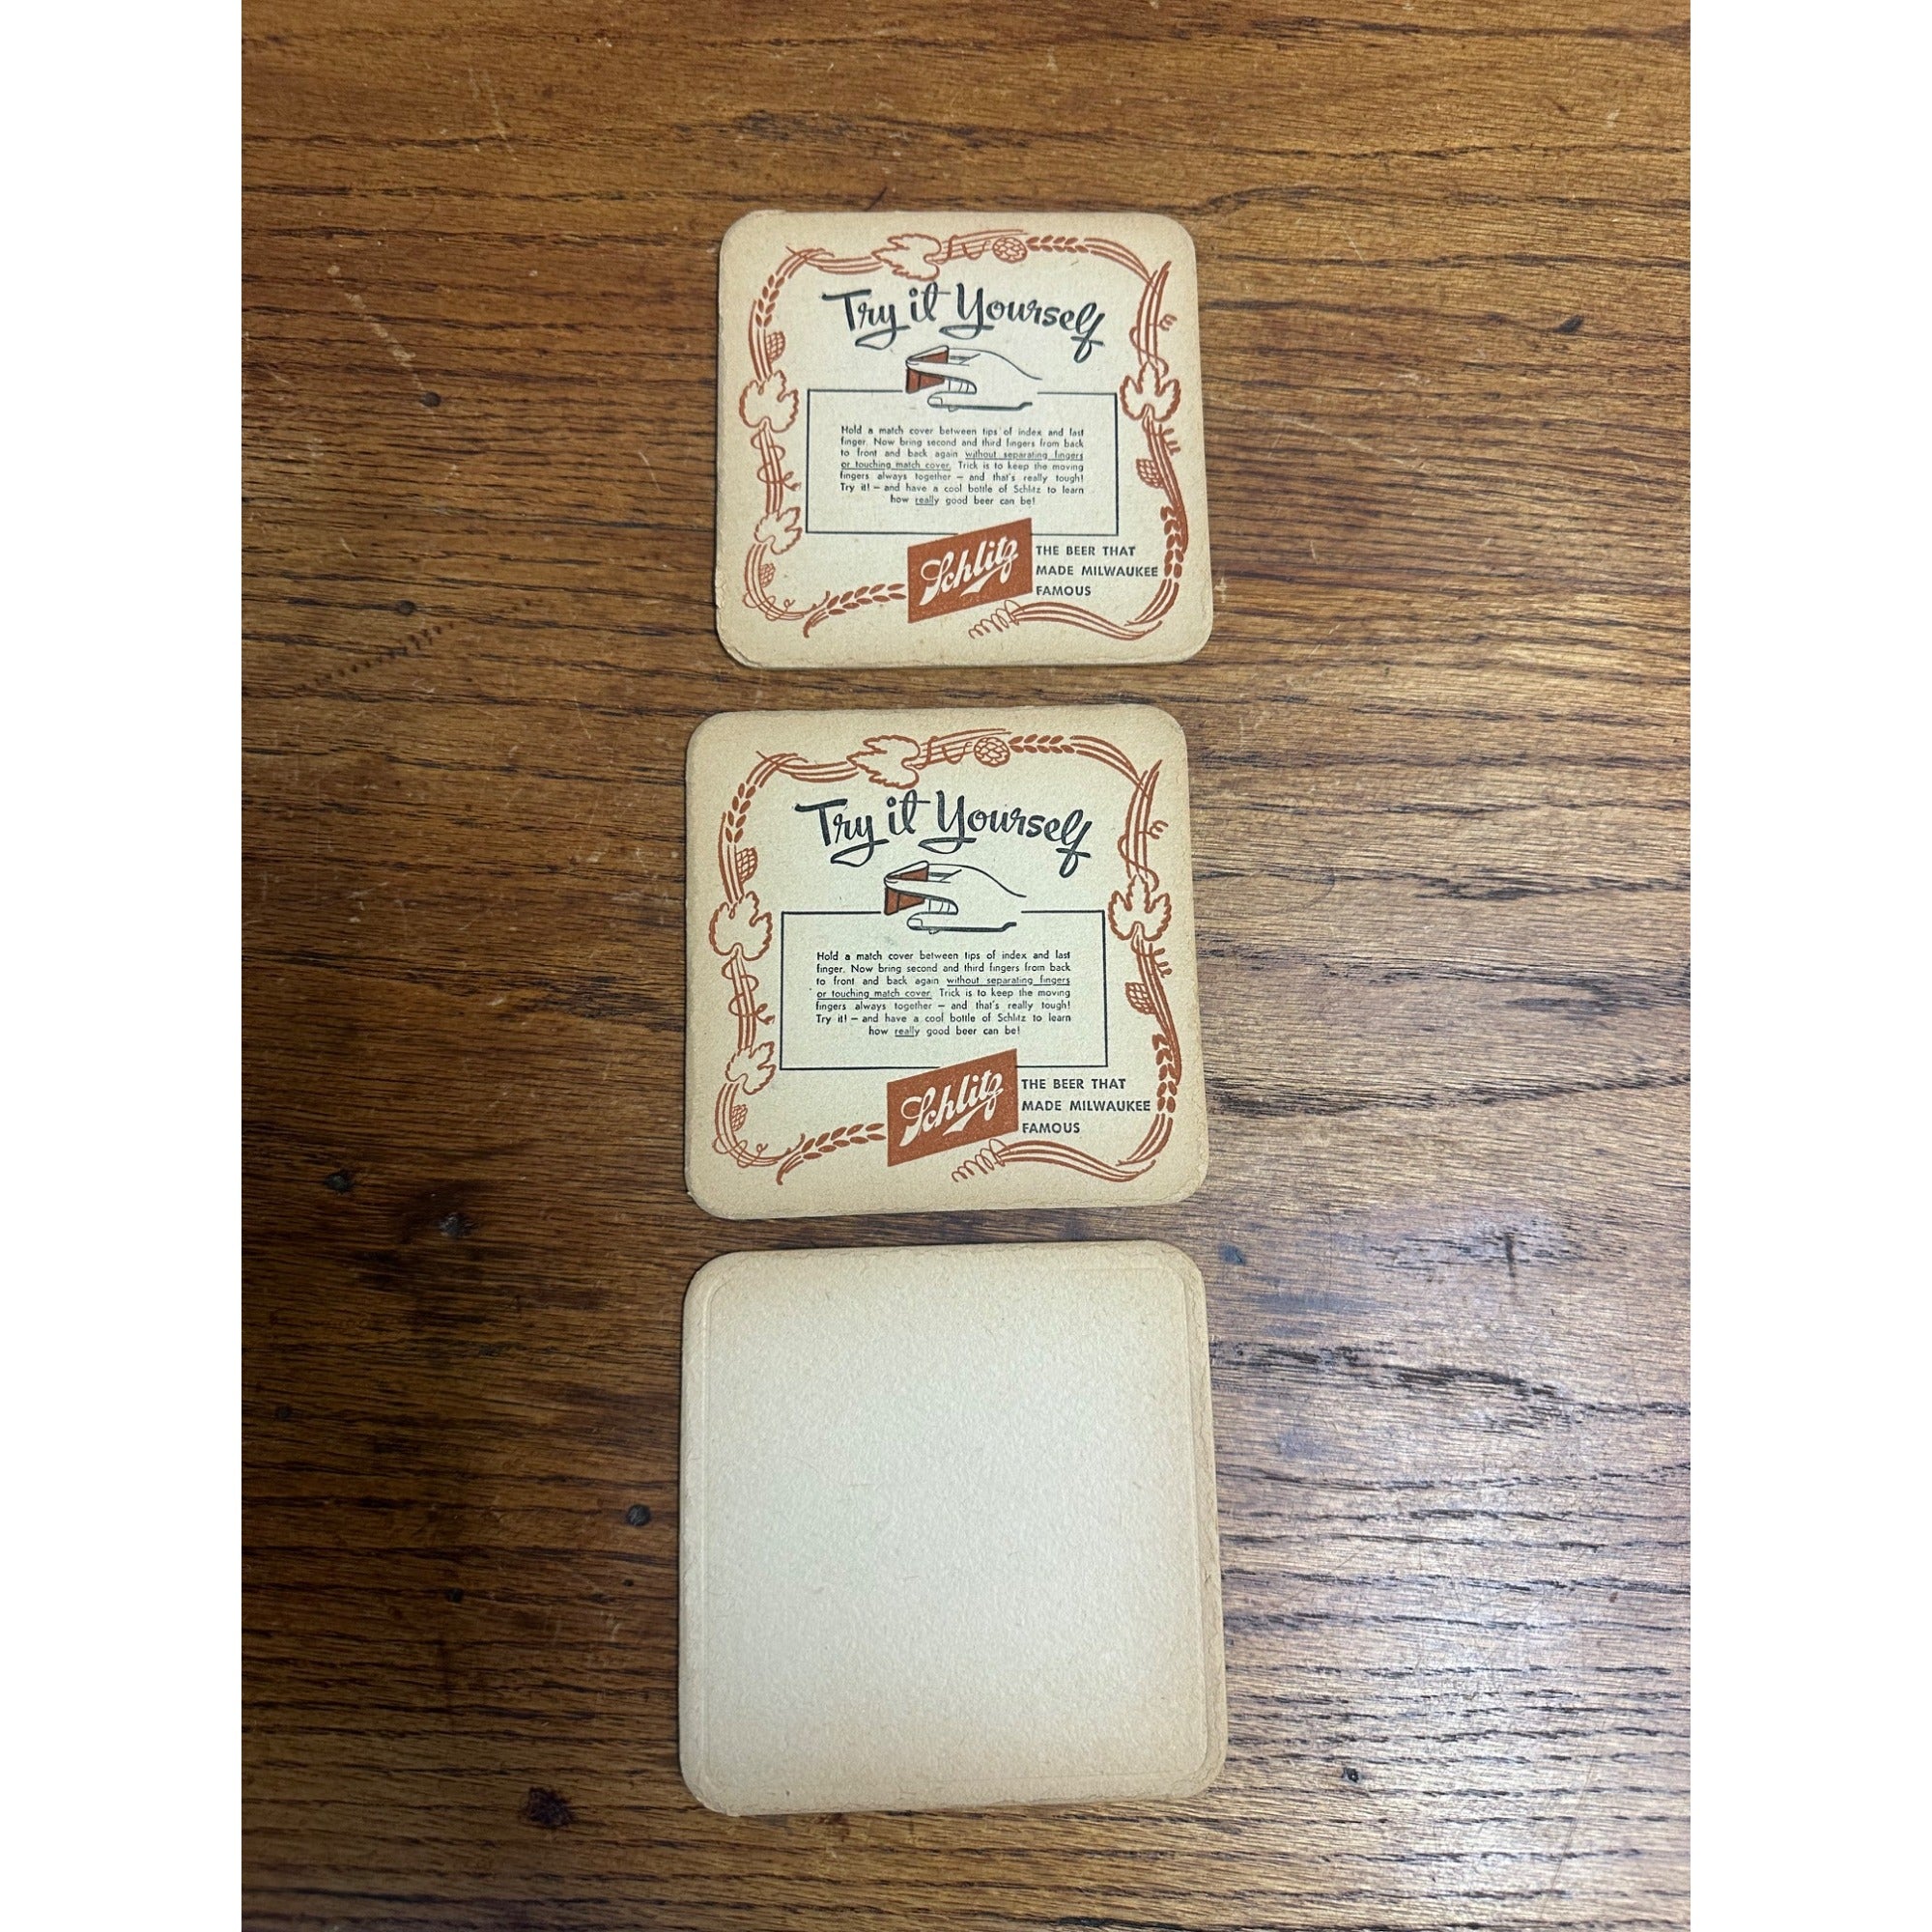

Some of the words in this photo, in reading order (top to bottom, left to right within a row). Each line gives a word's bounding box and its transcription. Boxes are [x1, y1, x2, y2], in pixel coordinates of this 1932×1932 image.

[821, 290, 911, 350] Try
[908, 282, 952, 322] it
[939, 283, 1105, 363] Yourself
[841, 426, 862, 435] Hold
[879, 426, 903, 436] match
[940, 426, 977, 436] between
[982, 427, 997, 438] tips
[1004, 427, 1012, 437] of
[1018, 427, 1041, 437] index
[1048, 428, 1064, 437] and
[1069, 428, 1084, 437] last
[900, 439, 923, 449] bring
[982, 439, 1002, 447] third
[1007, 439, 1035, 449] fingers
[1040, 439, 1059, 447] from
[1065, 439, 1084, 447] back
[908, 449, 927, 458] back
[935, 450, 958, 461] again
[966, 450, 997, 459] without
[1004, 450, 1048, 462] separating
[1055, 450, 1084, 461] fingers
[855, 461, 892, 470] touching
[895, 461, 921, 469] match
[958, 461, 979, 469] Trick
[1008, 462, 1029, 473] keep
[1053, 463, 1084, 472] moving
[840, 471, 869, 482] fingers
[877, 471, 907, 483] always
[915, 472, 952, 483] together
[970, 472, 985, 481] and
[993, 472, 1015, 482] that's
[1023, 473, 1048, 484] really
[1056, 473, 1083, 484] tough!
[840, 484, 855, 494] Try
[905, 484, 927, 493] have
[945, 484, 962, 493] cool
[968, 484, 992, 493] bottle
[999, 485, 1008, 494] of
[1013, 485, 1040, 494] Schlitz
[1047, 485, 1056, 494] to
[1063, 485, 1084, 494] learn
[891, 495, 909, 503] how
[916, 496, 939, 506] really
[946, 496, 968, 506] good
[974, 496, 993, 504] beer
[1021, 497, 1036, 505] be!
[1037, 546, 1059, 555] THE
[1066, 547, 1095, 555] BEER
[1102, 547, 1136, 556] THAT
[920, 535, 1019, 606] Schlitz
[1037, 566, 1074, 576] MADE
[1082, 566, 1158, 577] MILWAUKEE
[1037, 586, 1092, 596] FAMOUS
[795, 798, 889, 867] Try
[887, 789, 931, 835] it
[918, 790, 1093, 878] Yourself
[816, 952, 838, 960] Hold
[857, 952, 882, 960] match
[920, 952, 958, 960] between
[965, 952, 980, 962] tips
[987, 951, 996, 959] of
[851, 964, 872, 973] Now
[878, 964, 901, 975] bring
[907, 964, 937, 973] second
[990, 963, 1020, 974] fingers
[1025, 963, 1045, 972] from
[1050, 963, 1071, 972] back
[834, 977, 855, 985] front
[863, 977, 879, 985] and
[887, 977, 908, 985] back
[915, 977, 939, 986] again
[947, 977, 980, 985] without
[987, 977, 1033, 987] separating
[1040, 976, 1070, 986] fingers
[832, 989, 869, 1000] touching
[874, 989, 900, 998] match
[940, 989, 960, 998] Trick
[966, 989, 973, 998] is
[978, 989, 986, 998] to
[991, 988, 1013, 1000] keep
[1019, 988, 1034, 998] the
[1038, 988, 1070, 1000] moving
[816, 1002, 846, 1012] fingers
[855, 1002, 886, 1013] always
[895, 1002, 932, 1012] together
[952, 1002, 967, 1010] and
[976, 1002, 1000, 1010] that's
[1008, 1002, 1033, 1012] really
[1041, 1002, 1070, 1012] tough!
[816, 1014, 832, 1025] Try
[838, 1014, 847, 1023] it!
[863, 1014, 878, 1023] and
[885, 1014, 907, 1023] have
[925, 1014, 944, 1023] cool
[951, 1014, 976, 1023] bottle
[982, 1013, 991, 1022] of
[998, 1013, 1026, 1022] Schlitz
[1048, 1013, 1071, 1022] learn
[868, 1027, 889, 1036] how
[895, 1026, 921, 1037] really
[926, 1026, 950, 1037] good
[956, 1026, 977, 1036] beer
[1005, 1026, 1020, 1036] be!
[1022, 1079, 1046, 1089] THE
[1053, 1079, 1084, 1089] BEER
[1092, 1079, 1126, 1089] THAT
[899, 1068, 1004, 1148] Schlitz
[1022, 1101, 1062, 1111] MADE
[1070, 1100, 1151, 1112] MILWAUKEE
[1022, 1123, 1080, 1133] FAMOUS
